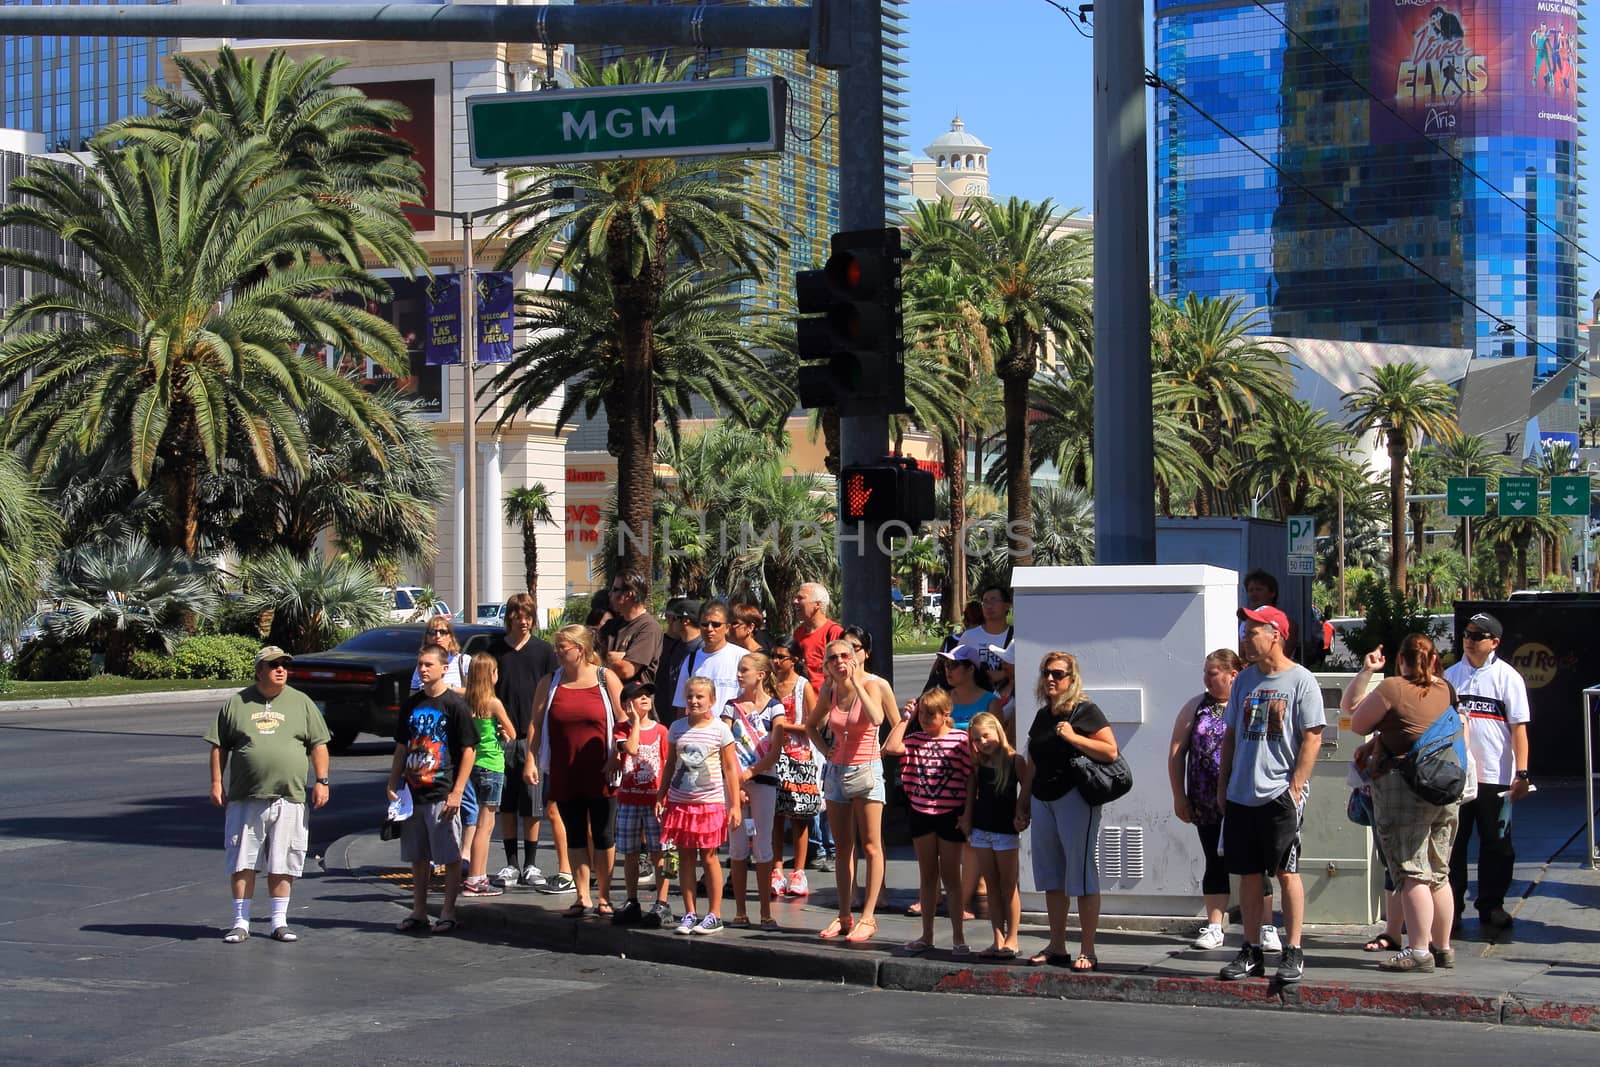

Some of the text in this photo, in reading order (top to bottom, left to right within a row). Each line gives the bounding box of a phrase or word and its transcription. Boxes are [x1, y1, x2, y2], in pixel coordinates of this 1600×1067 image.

[1537, 2, 1560, 13] MUSIC
[1412, 27, 1472, 64] Viva
[1396, 55, 1488, 98] ELVIS
[562, 105, 677, 141] MGM
[1424, 108, 1456, 133] Aria
[430, 314, 457, 323] WELCOME
[480, 312, 509, 321] WELCOME
[433, 326, 450, 337] LAS
[483, 324, 501, 334] LAS
[431, 335, 457, 346] VEGAS
[482, 333, 510, 344] VEGAS
[565, 505, 601, 525] VS
[1289, 519, 1301, 552] P
[1290, 561, 1312, 570] 50 FEET
[1513, 651, 1535, 668] rd
[406, 752, 436, 769] KISS
